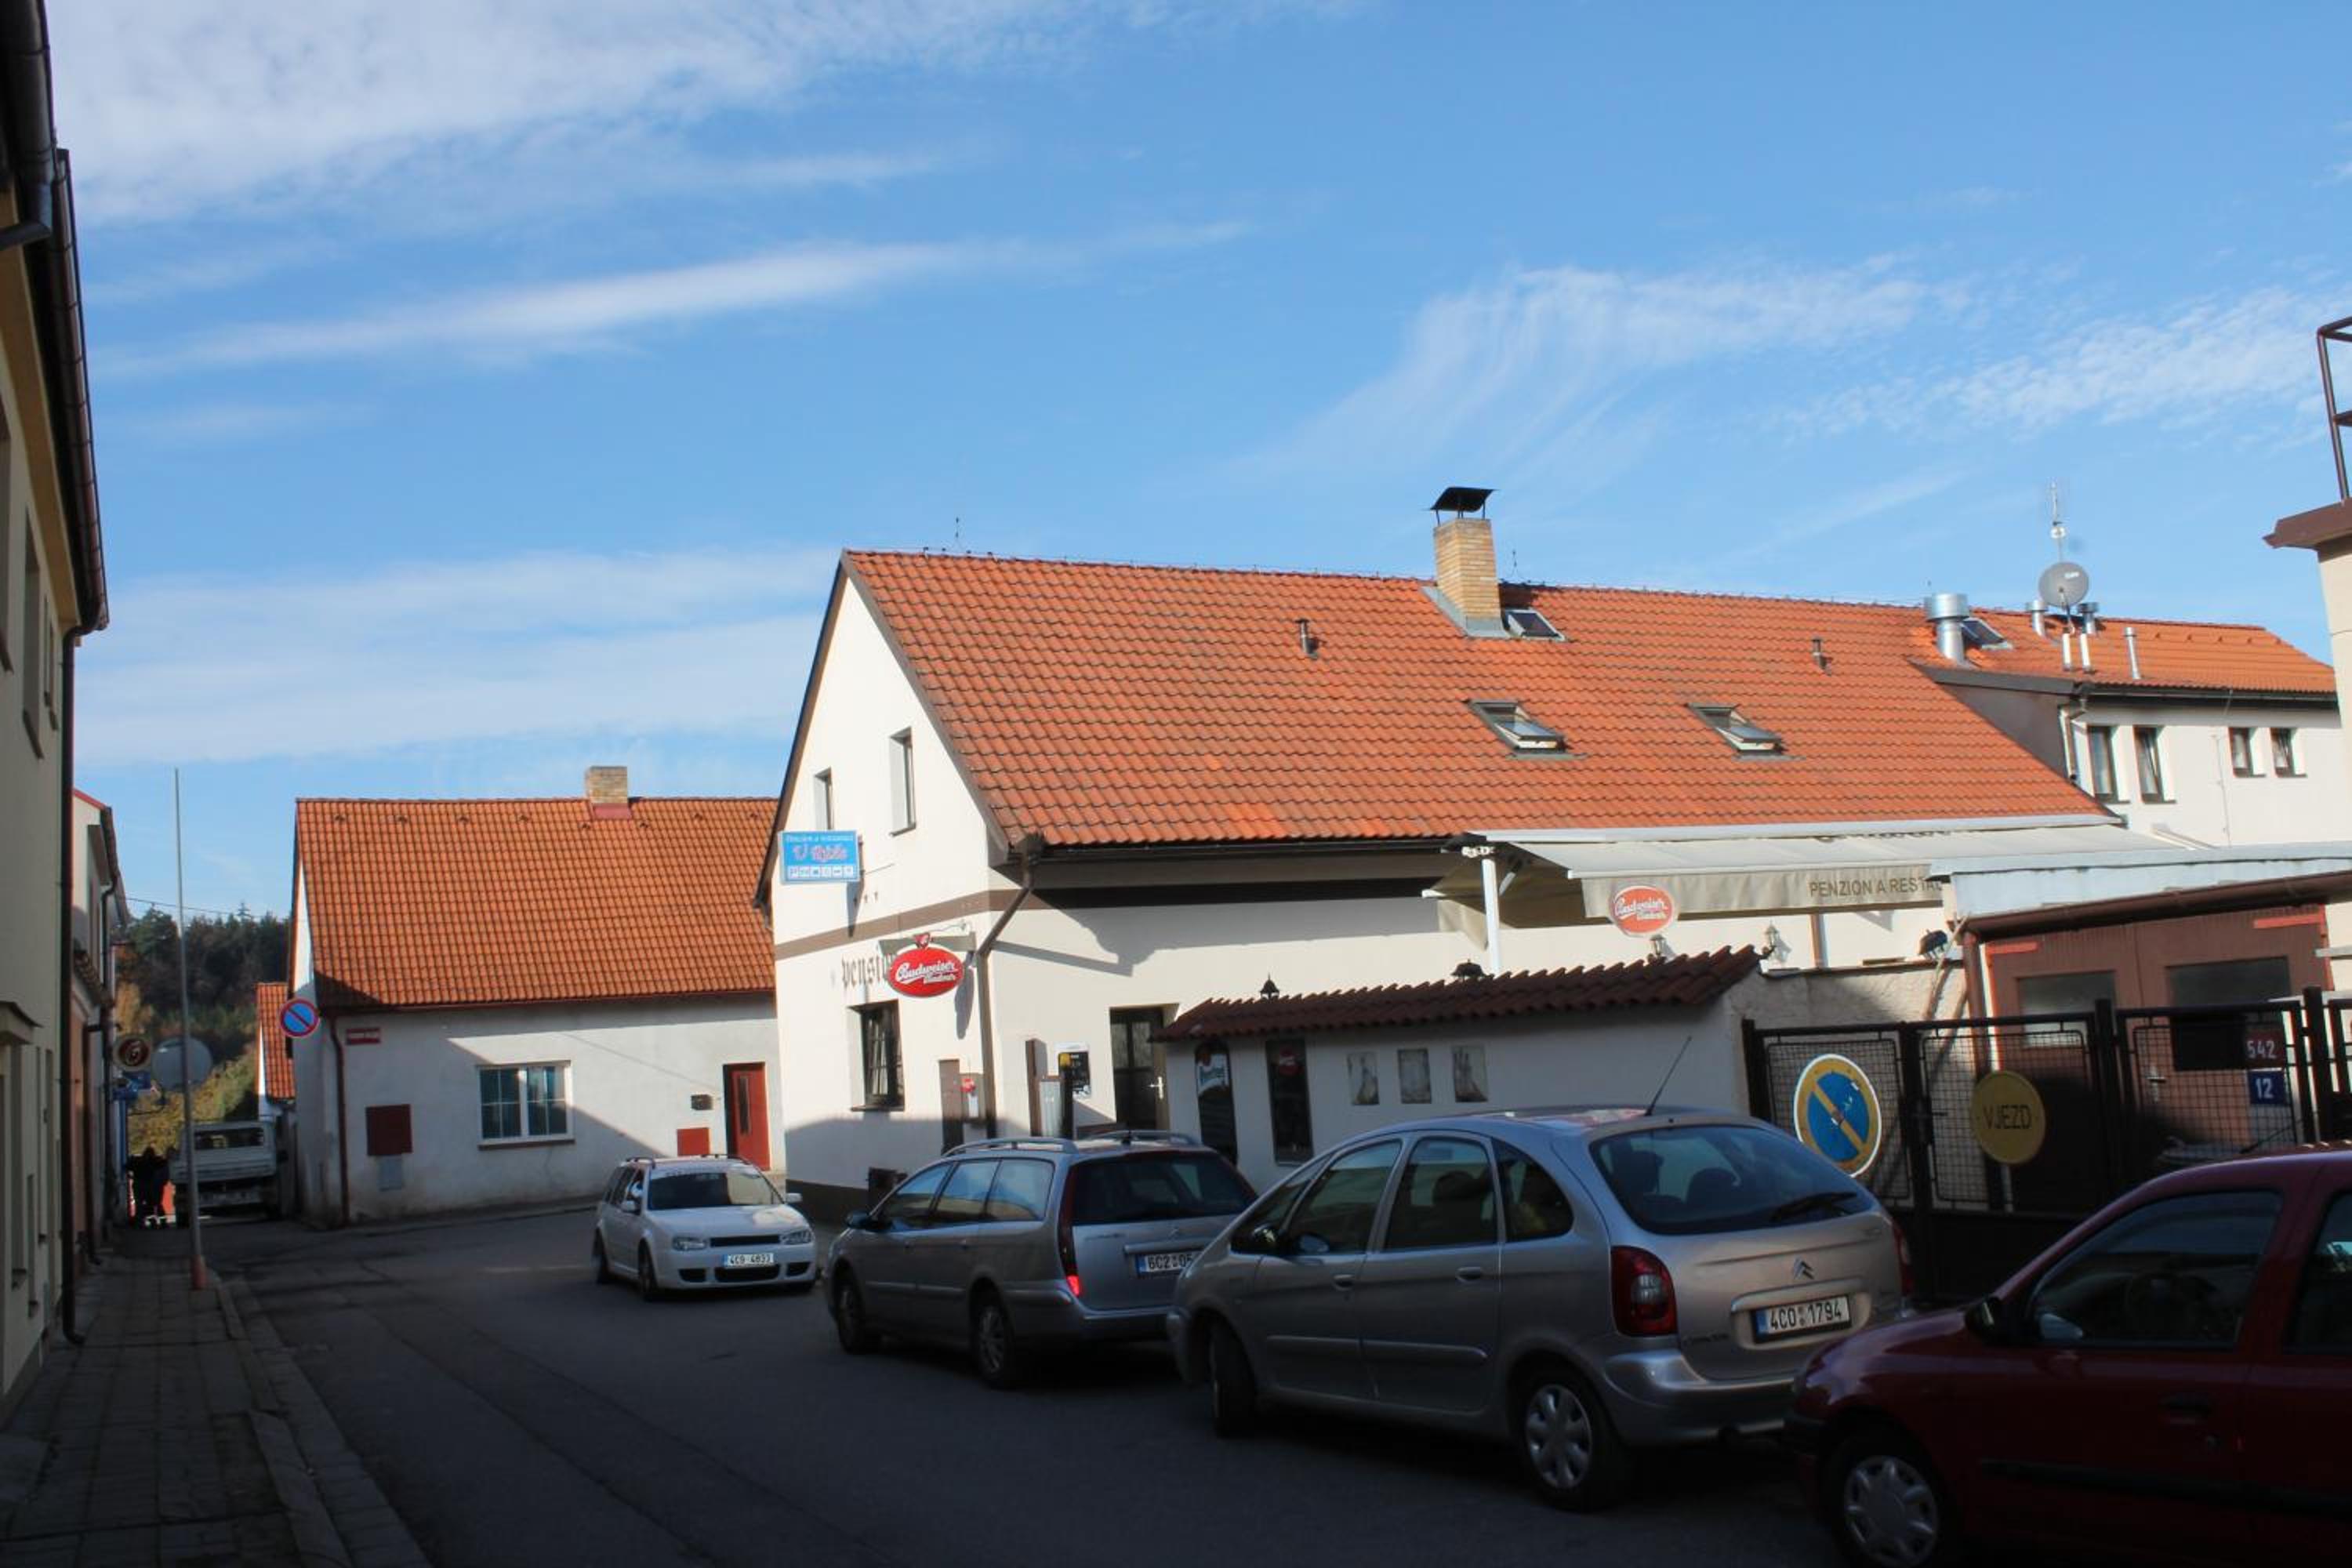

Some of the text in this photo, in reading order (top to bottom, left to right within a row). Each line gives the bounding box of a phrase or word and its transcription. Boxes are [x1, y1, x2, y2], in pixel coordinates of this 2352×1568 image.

[1809, 880, 1873, 897] PENZION
[1877, 880, 1887, 894] A
[2247, 1040, 2277, 1059] 542
[2256, 1078, 2274, 1098] 12
[1982, 1105, 2033, 1129] VJEZD
[1808, 1301, 1842, 1324] 1794
